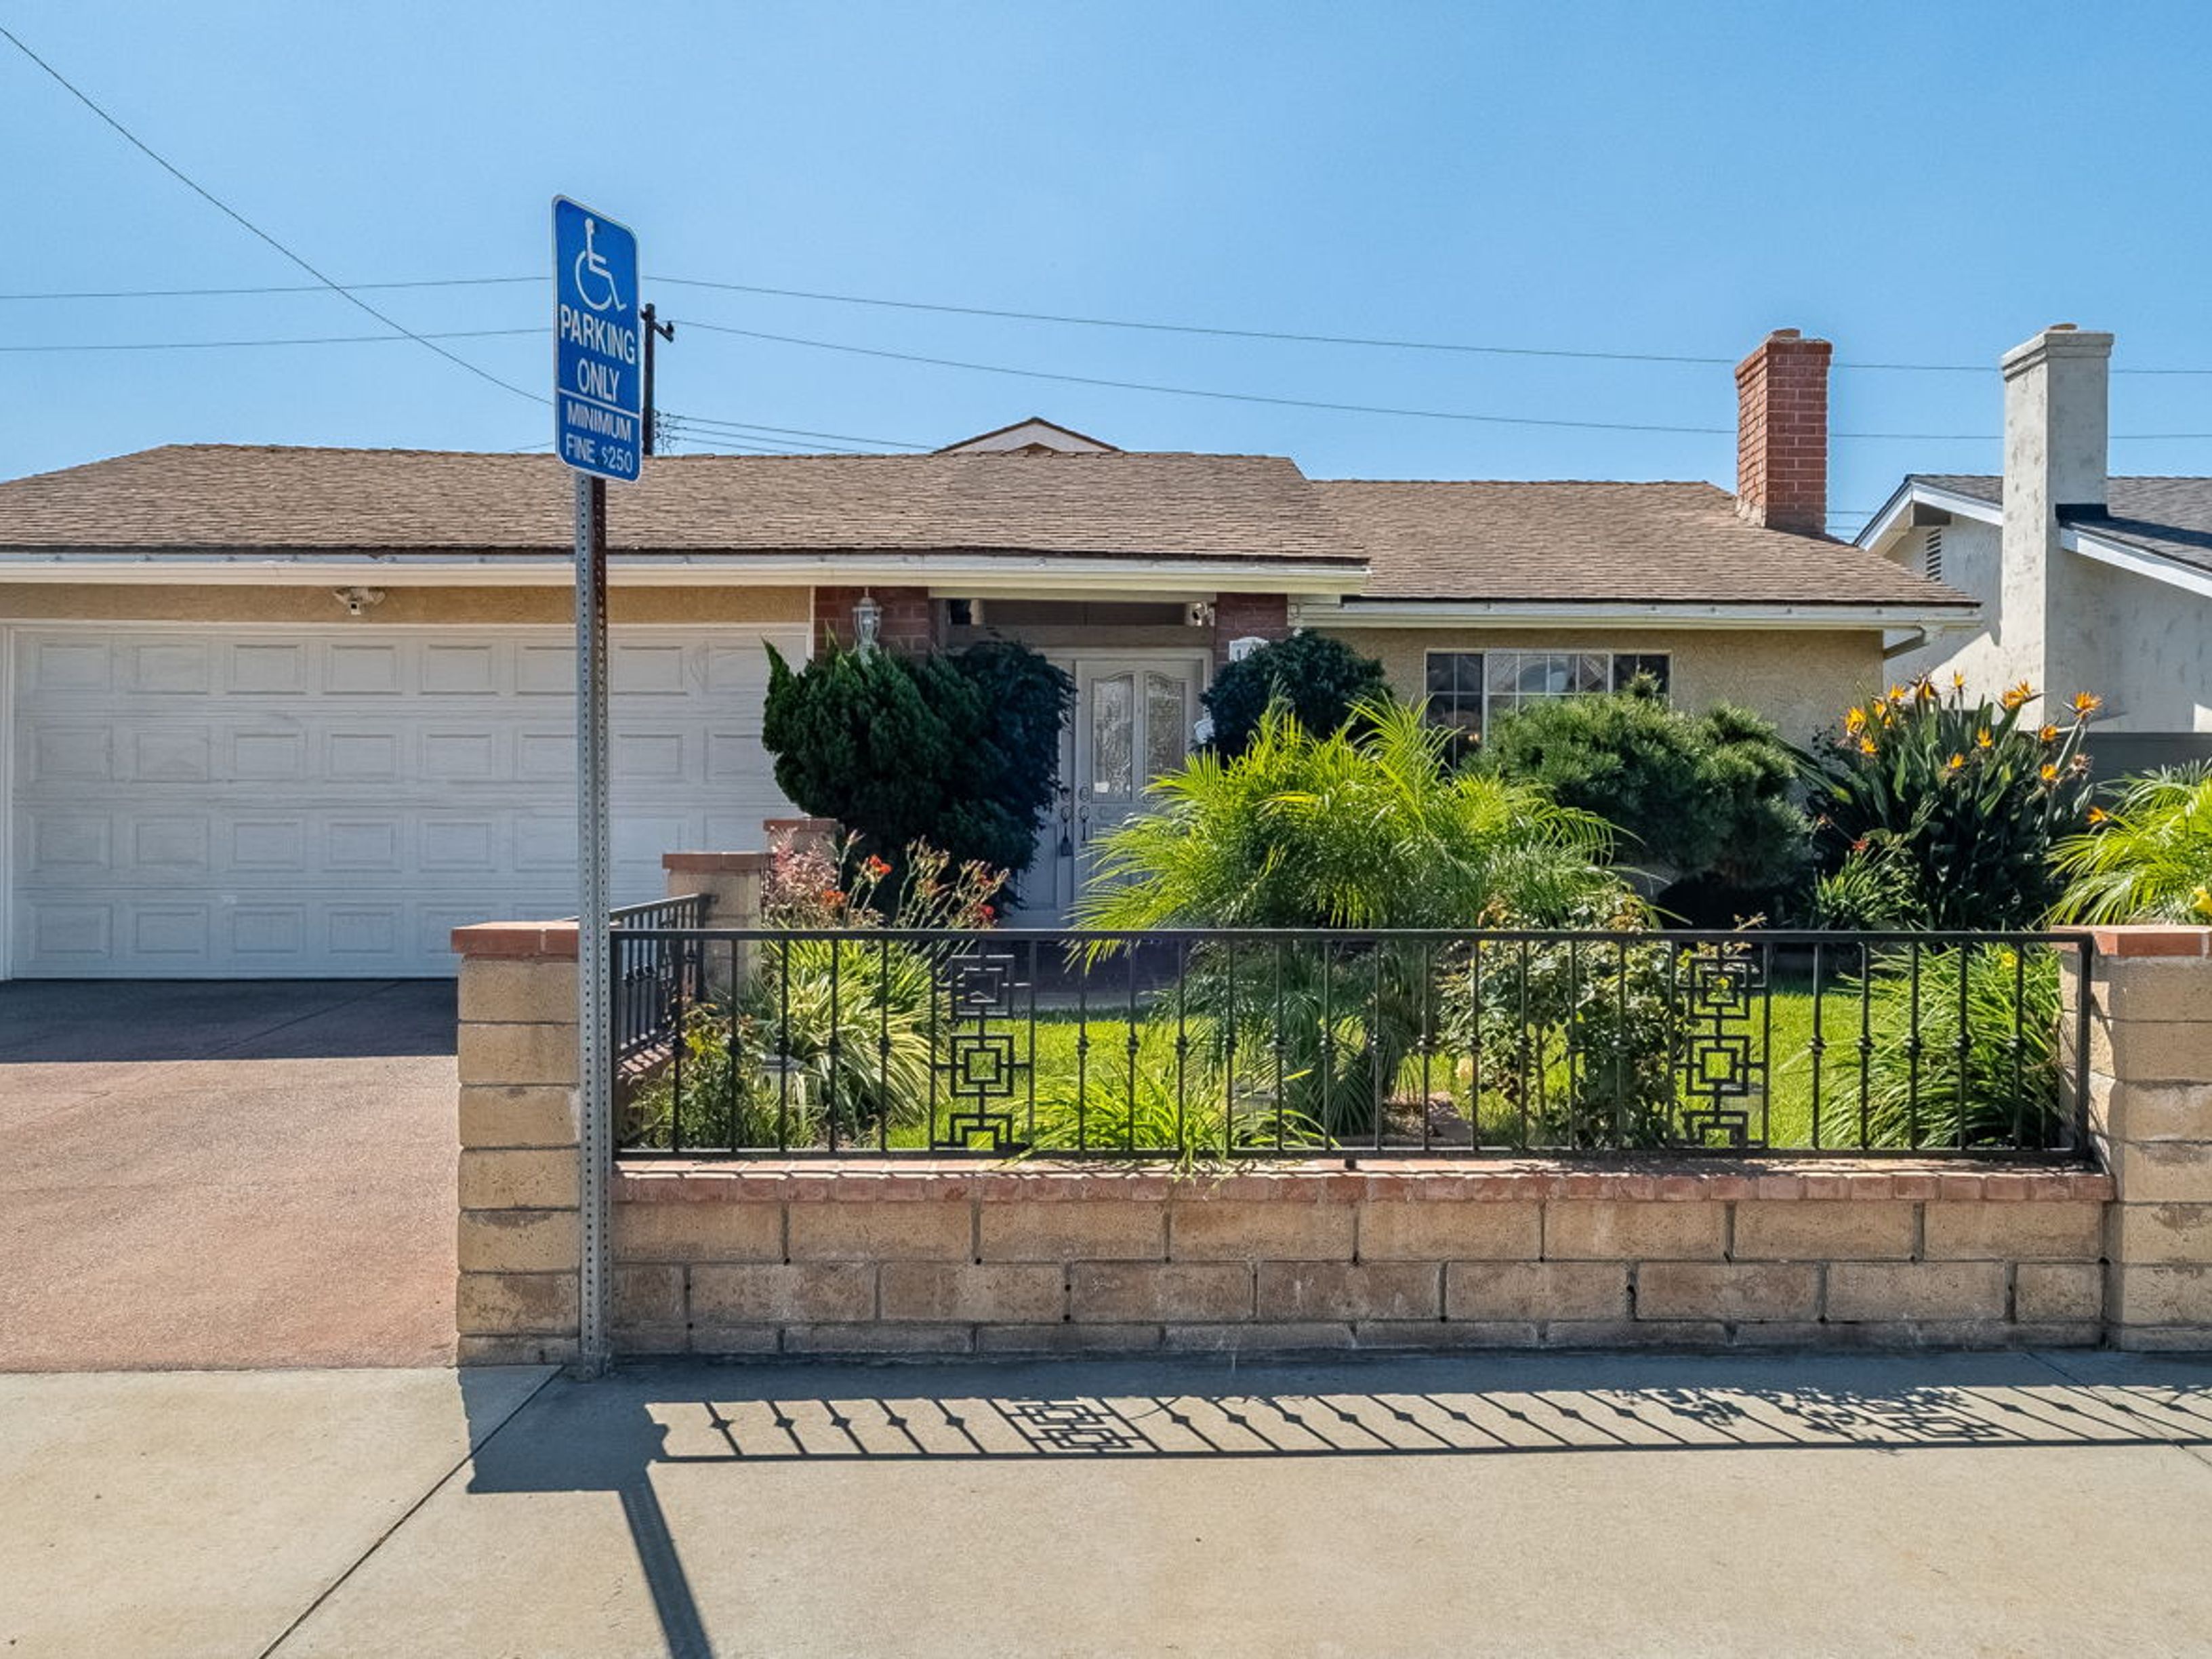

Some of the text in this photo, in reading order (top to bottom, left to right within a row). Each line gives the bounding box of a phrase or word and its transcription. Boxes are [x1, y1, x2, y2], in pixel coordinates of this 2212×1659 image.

[560, 304, 635, 364] PARKING
[577, 358, 619, 403] ONLY
[567, 401, 632, 443] MINIMUM
[566, 432, 633, 472] FINE $250
